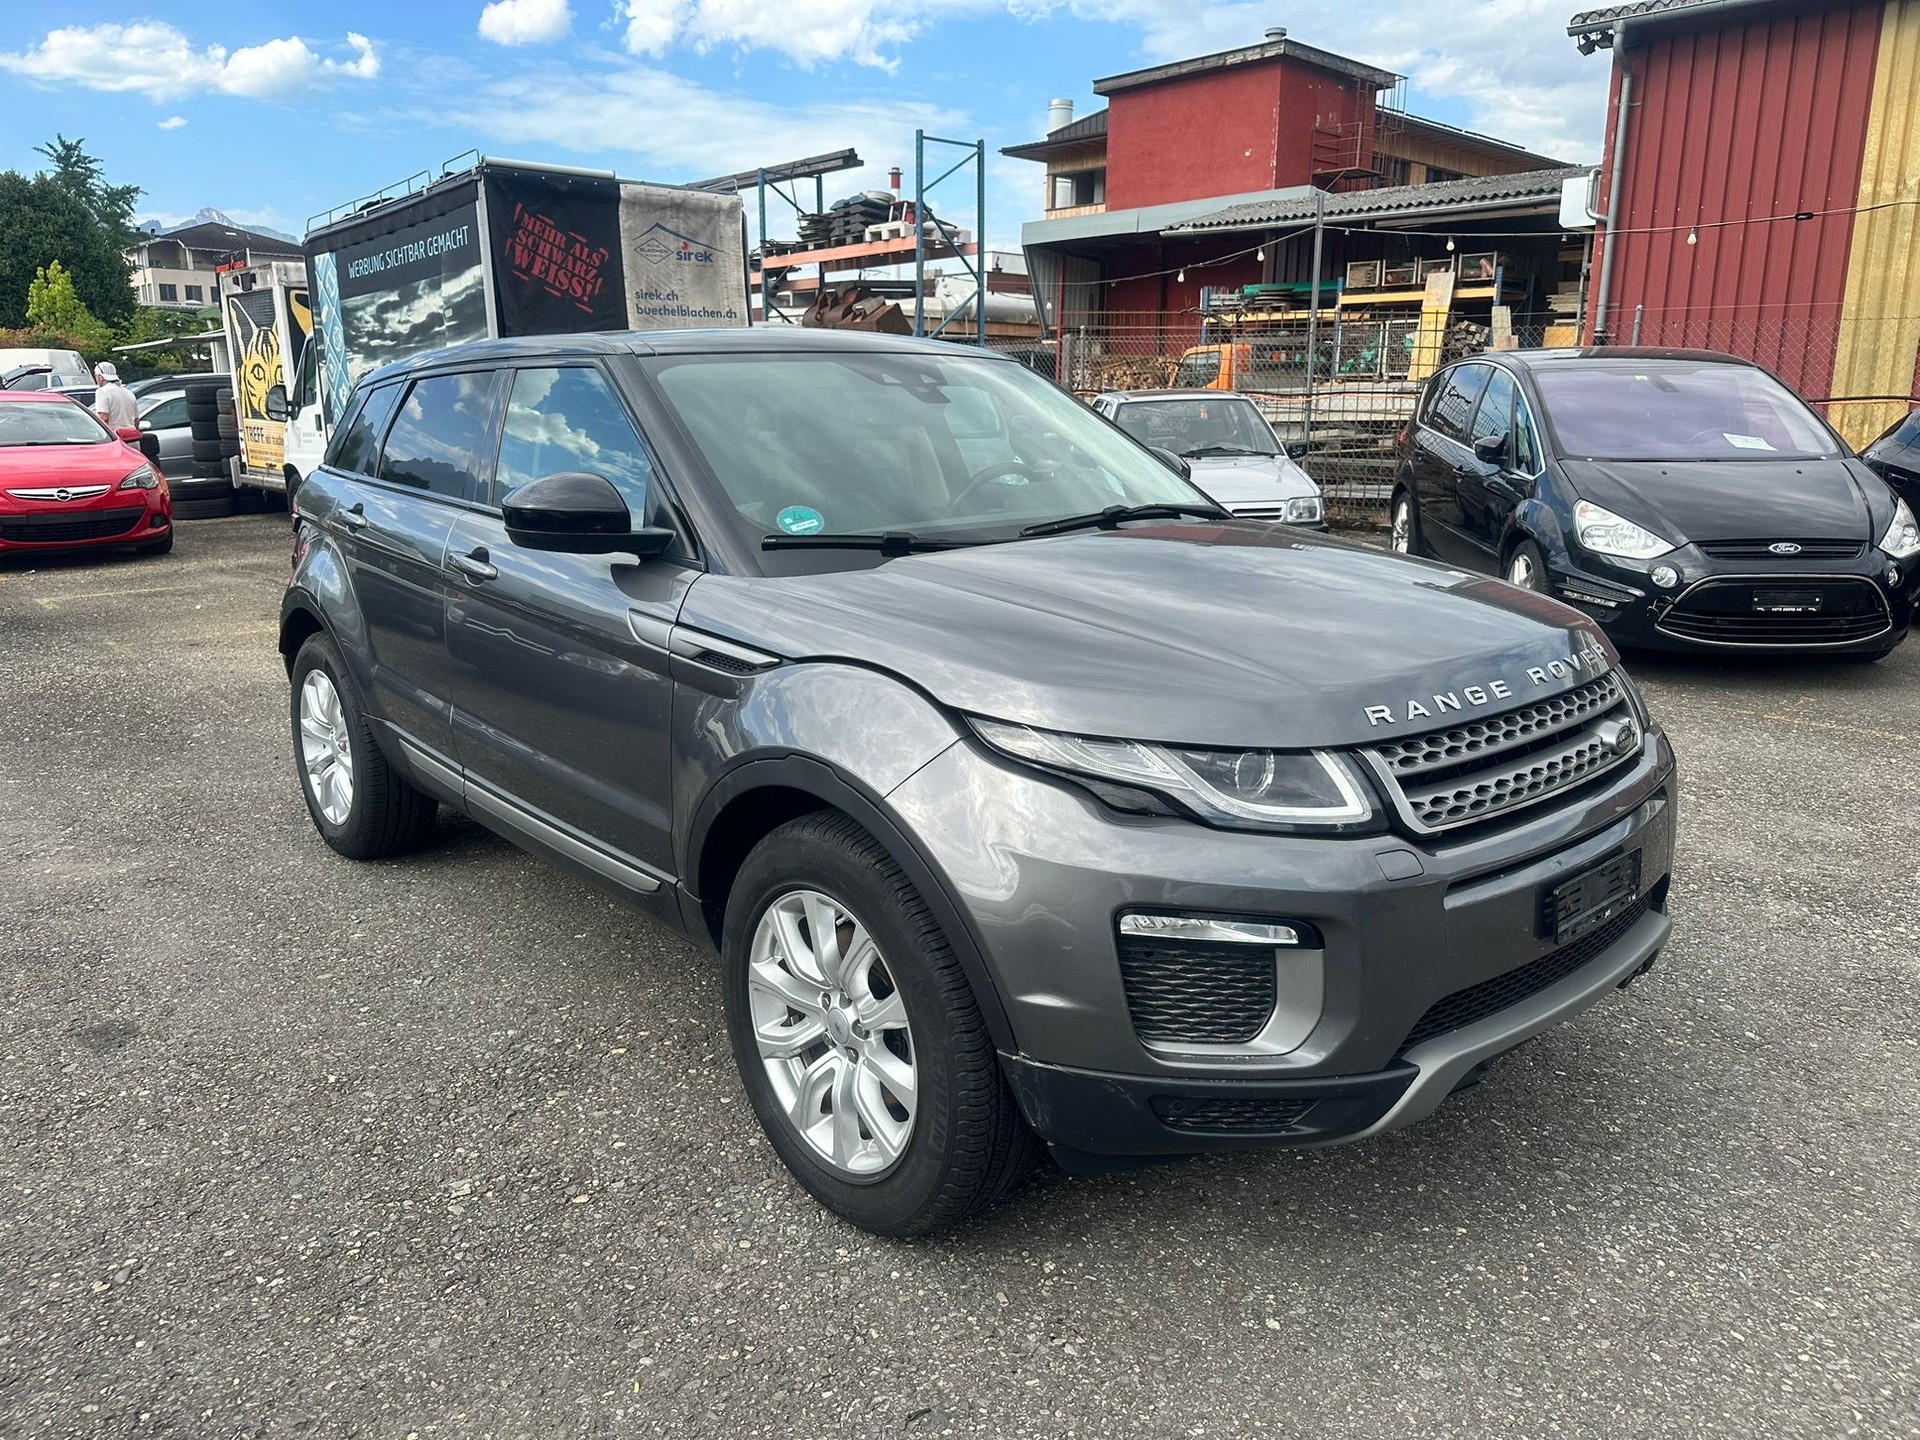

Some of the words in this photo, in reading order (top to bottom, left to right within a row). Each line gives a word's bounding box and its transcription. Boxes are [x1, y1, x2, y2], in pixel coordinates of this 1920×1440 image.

[348, 253, 384, 279] WERBUNG
[386, 241, 426, 269] SICHTBAR
[427, 225, 469, 256] GEMACHT
[516, 229, 598, 282] SCHWARZ
[521, 212, 567, 249] MEHR
[570, 243, 601, 267] ALS
[676, 243, 714, 263] sirek
[514, 243, 593, 302] WEISS!
[634, 289, 679, 301] sirek.ch
[636, 303, 737, 318] buechelblachen.ch
[1775, 543, 1796, 552] Ford
[1363, 679, 1513, 727] RANGE
[1525, 643, 1609, 686] ROVER
